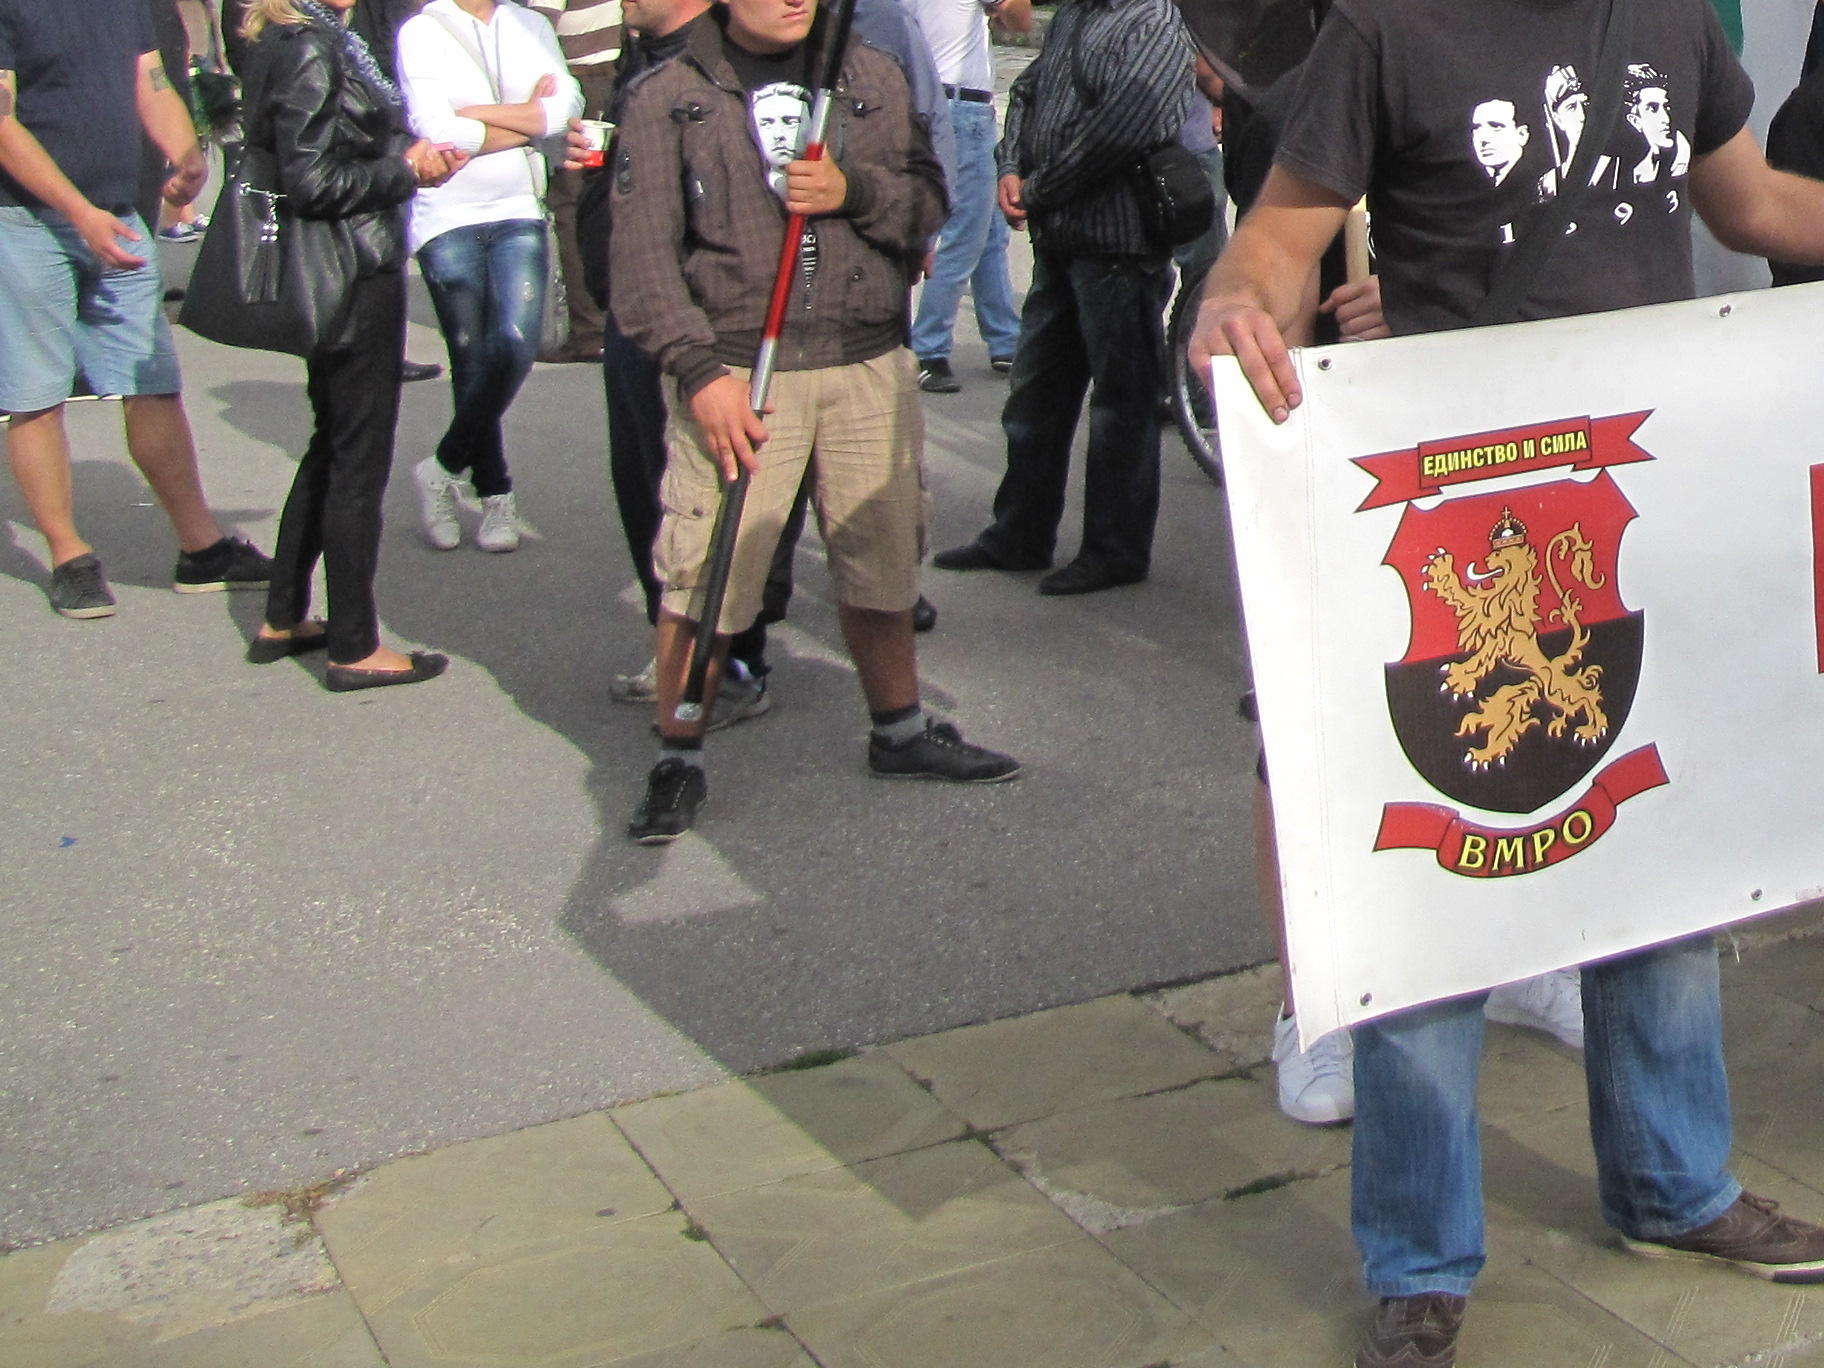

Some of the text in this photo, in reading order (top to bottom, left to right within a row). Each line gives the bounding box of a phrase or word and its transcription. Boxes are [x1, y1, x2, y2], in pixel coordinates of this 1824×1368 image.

[1423, 430, 1588, 478] ЕДИНСТВО И СИЛА
[1458, 808, 1594, 872] ВМРО
